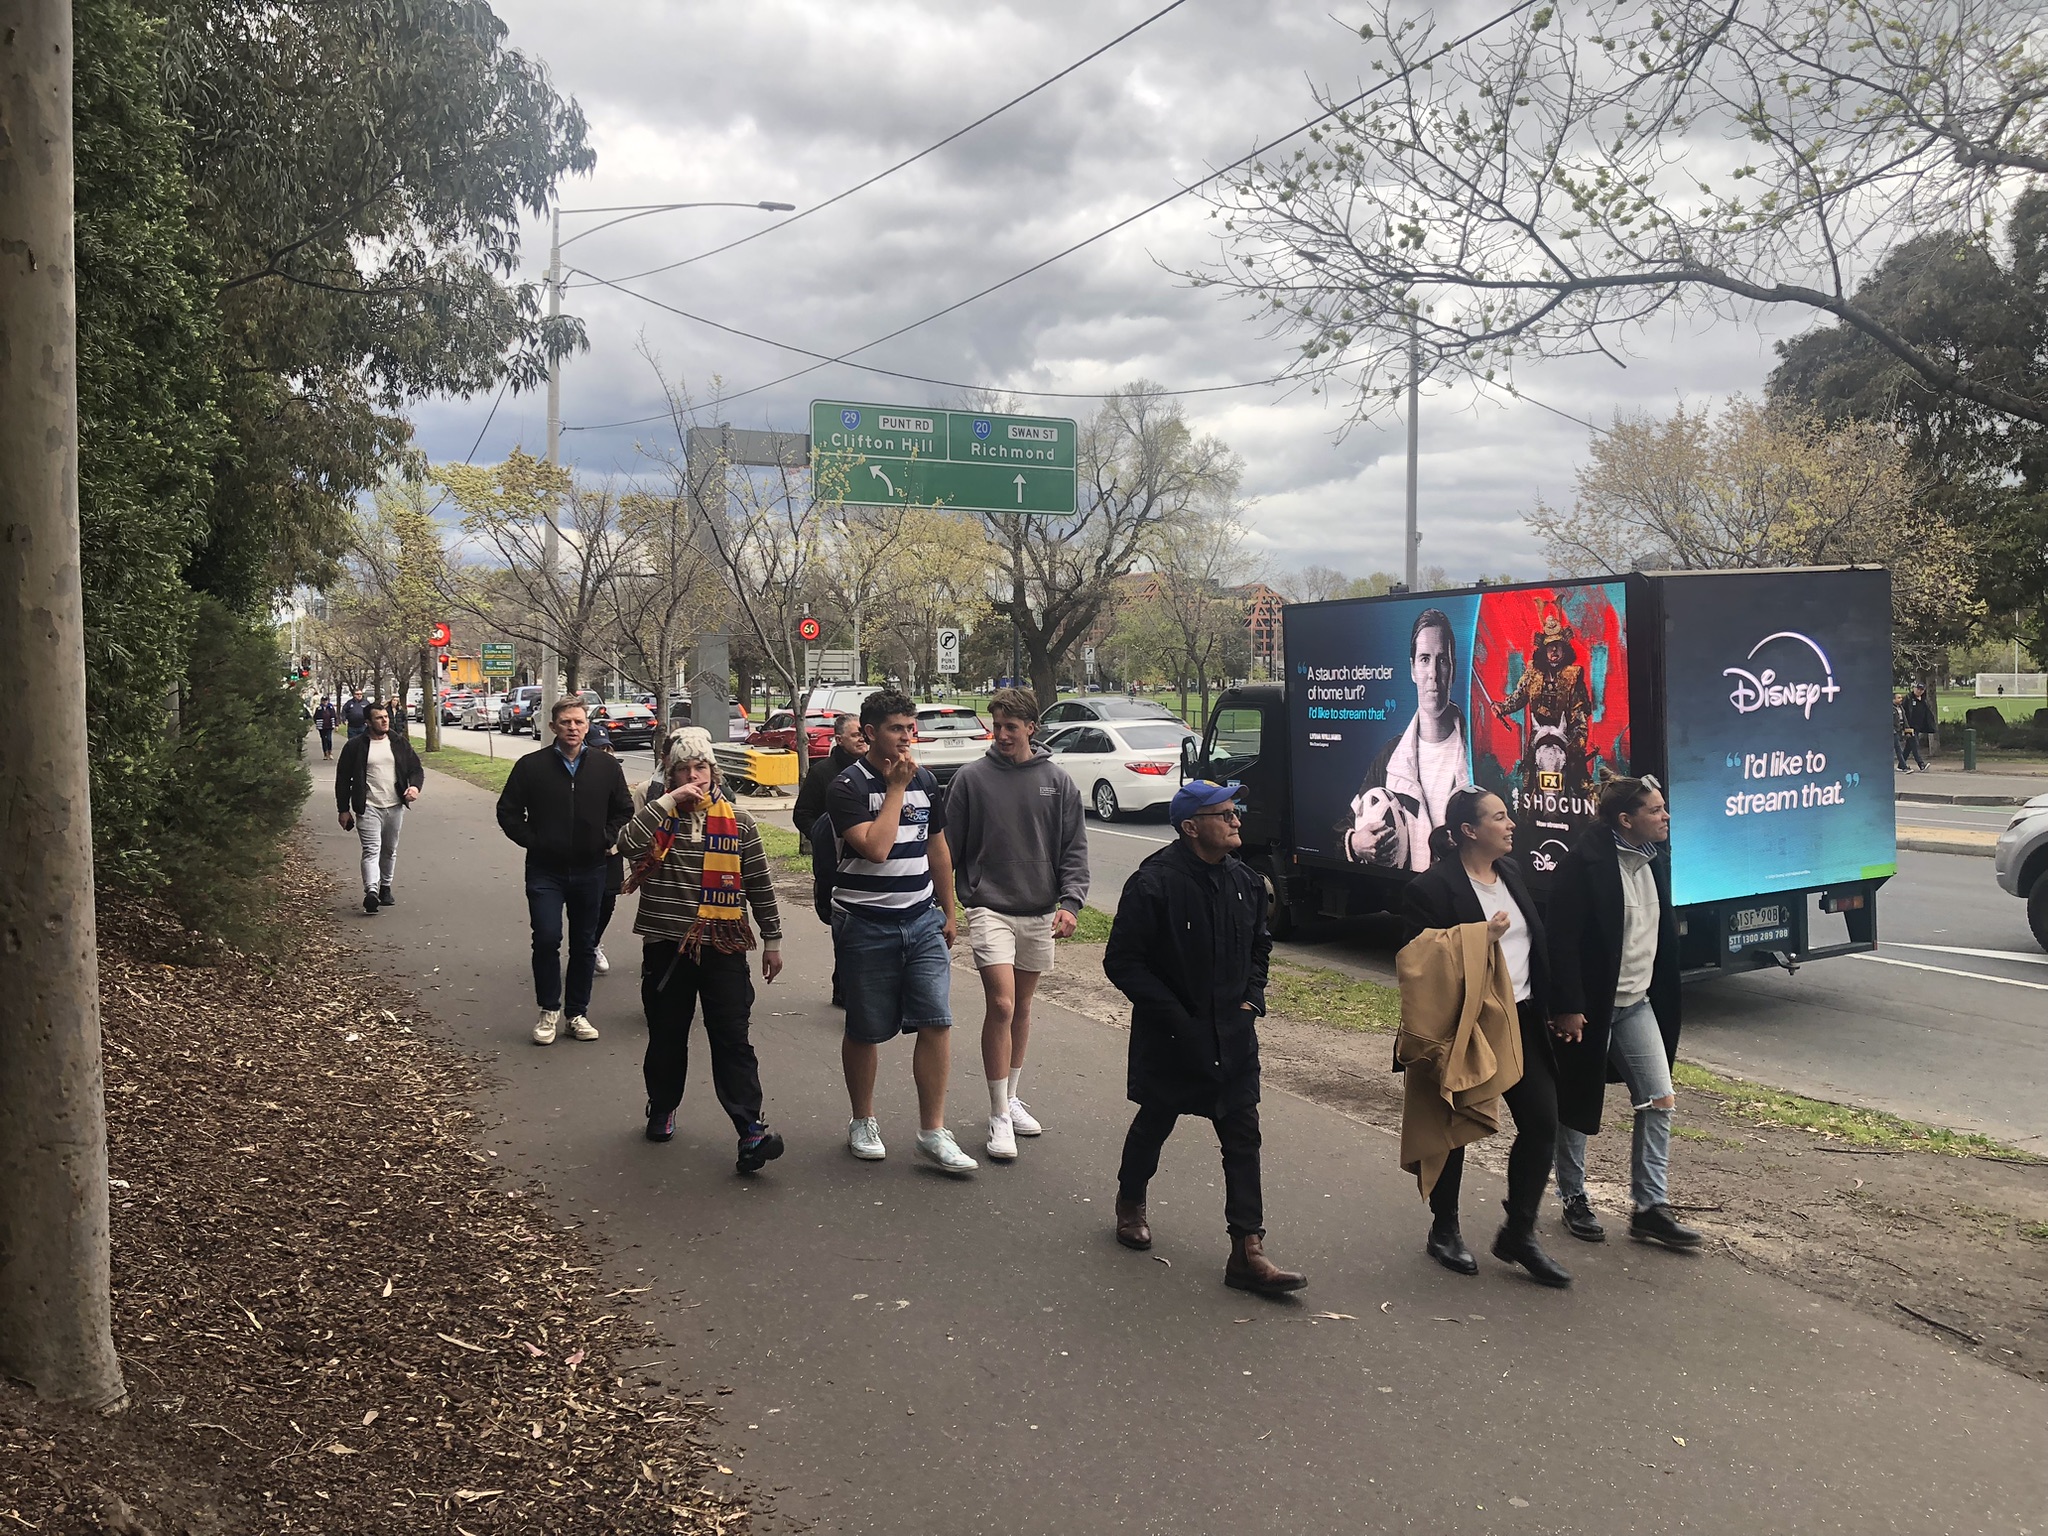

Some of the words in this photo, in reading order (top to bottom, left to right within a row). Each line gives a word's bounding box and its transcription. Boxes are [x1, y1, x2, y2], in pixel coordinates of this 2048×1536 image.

[844, 411, 858, 424] 29
[882, 417, 912, 430] PUNT
[914, 420, 930, 432] RD
[976, 421, 989, 434] 20
[1011, 427, 1041, 439] SWAN
[1042, 428, 1055, 440] ST
[831, 433, 894, 450] Clifton
[901, 437, 933, 453] Hill
[970, 443, 1055, 460] Richmond
[803, 624, 815, 634] 60
[1315, 665, 1351, 680] staunch
[1351, 665, 1394, 680] defender
[1307, 685, 1317, 700] of
[1317, 686, 1343, 700] home
[1344, 684, 1366, 700] turf?
[1317, 706, 1330, 719] like
[1330, 707, 1339, 719] to
[1339, 708, 1367, 720] stream
[1769, 750, 1803, 778] like
[1805, 750, 1827, 774] to
[1543, 775, 1558, 787] FX
[1523, 792, 1596, 816] SHŌGUN
[1725, 790, 1799, 817] stream
[703, 890, 741, 905] LIONS
[1729, 935, 1741, 946] STT
[1742, 933, 1759, 944] 1300
[1760, 931, 1773, 941] 289
[1775, 929, 1788, 939] 788
